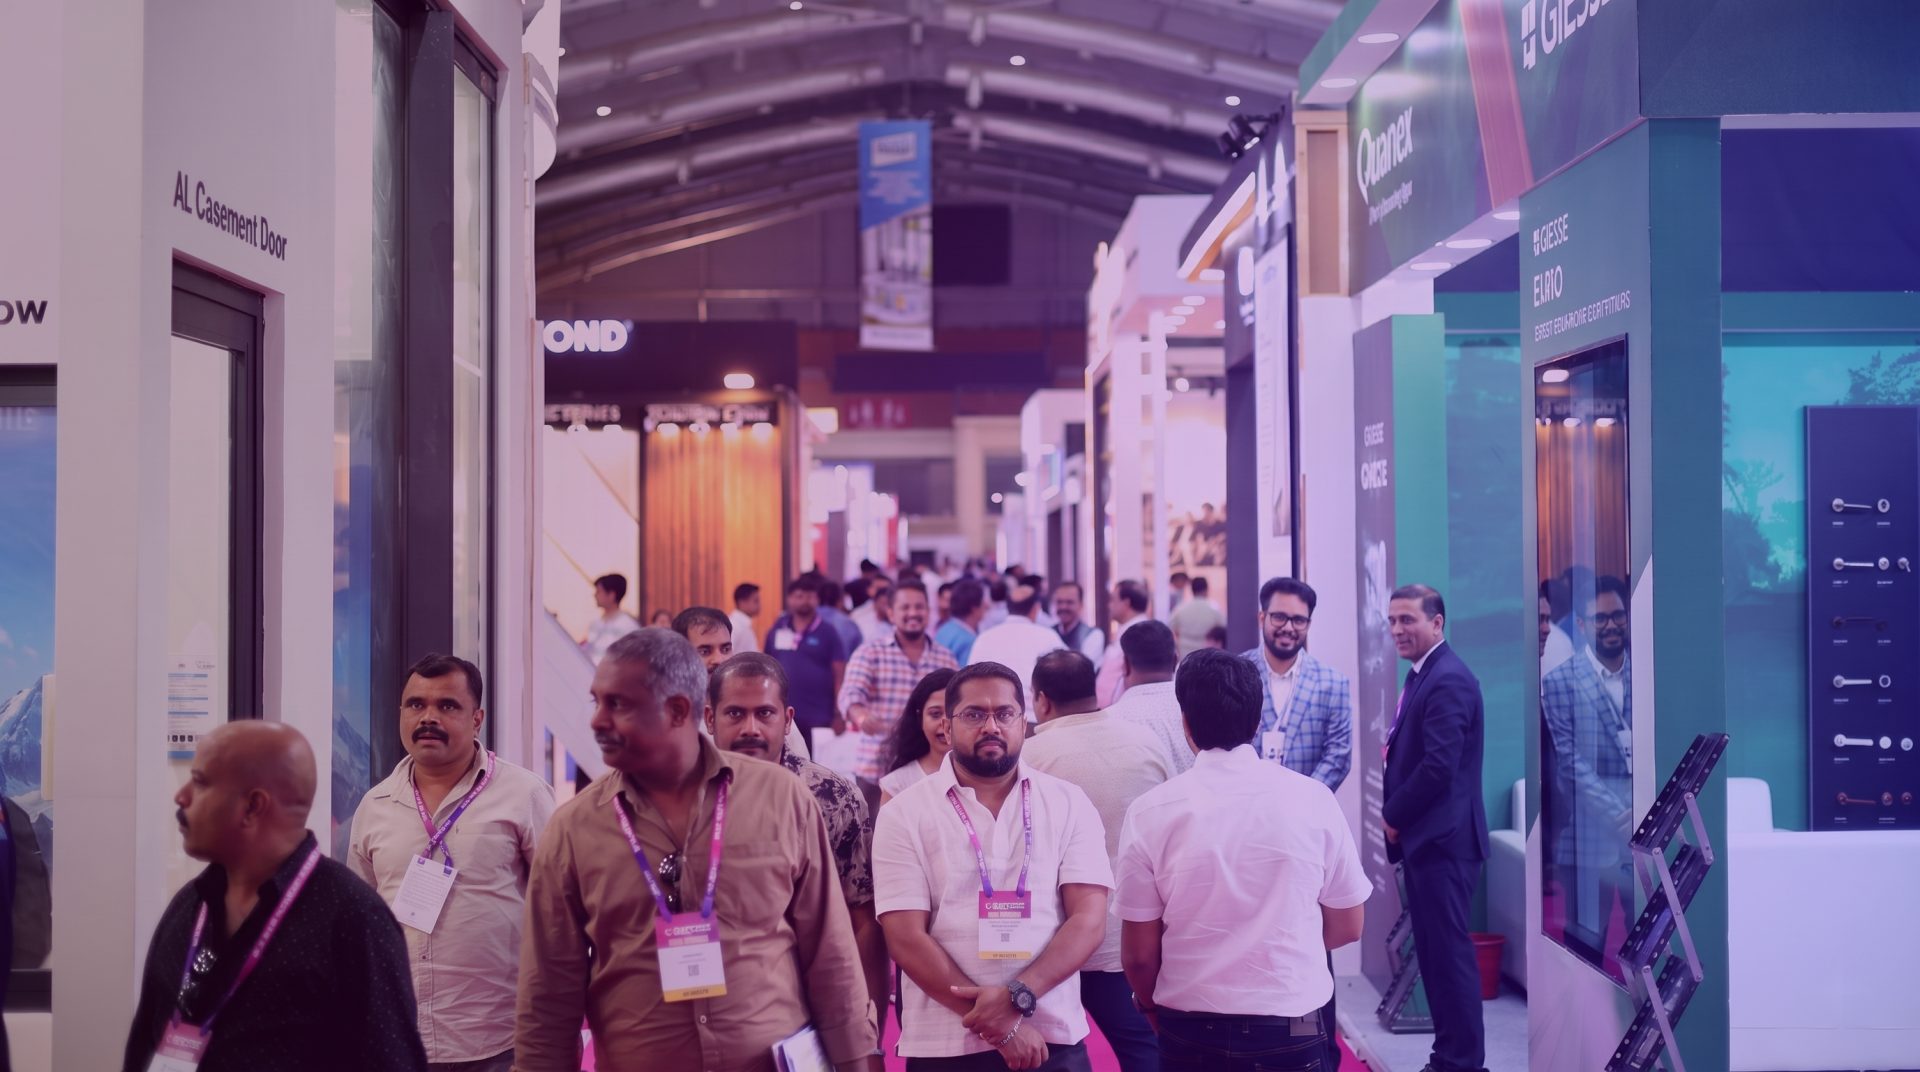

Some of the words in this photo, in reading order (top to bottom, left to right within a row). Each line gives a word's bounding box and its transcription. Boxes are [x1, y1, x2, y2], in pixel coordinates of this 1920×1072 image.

[1541, 0, 1611, 54] GIE
[1356, 106, 1413, 205] Quanex
[173, 170, 192, 214] AL
[196, 180, 257, 248] Casement
[260, 216, 287, 261] Door
[1540, 213, 1569, 253] GIESSE
